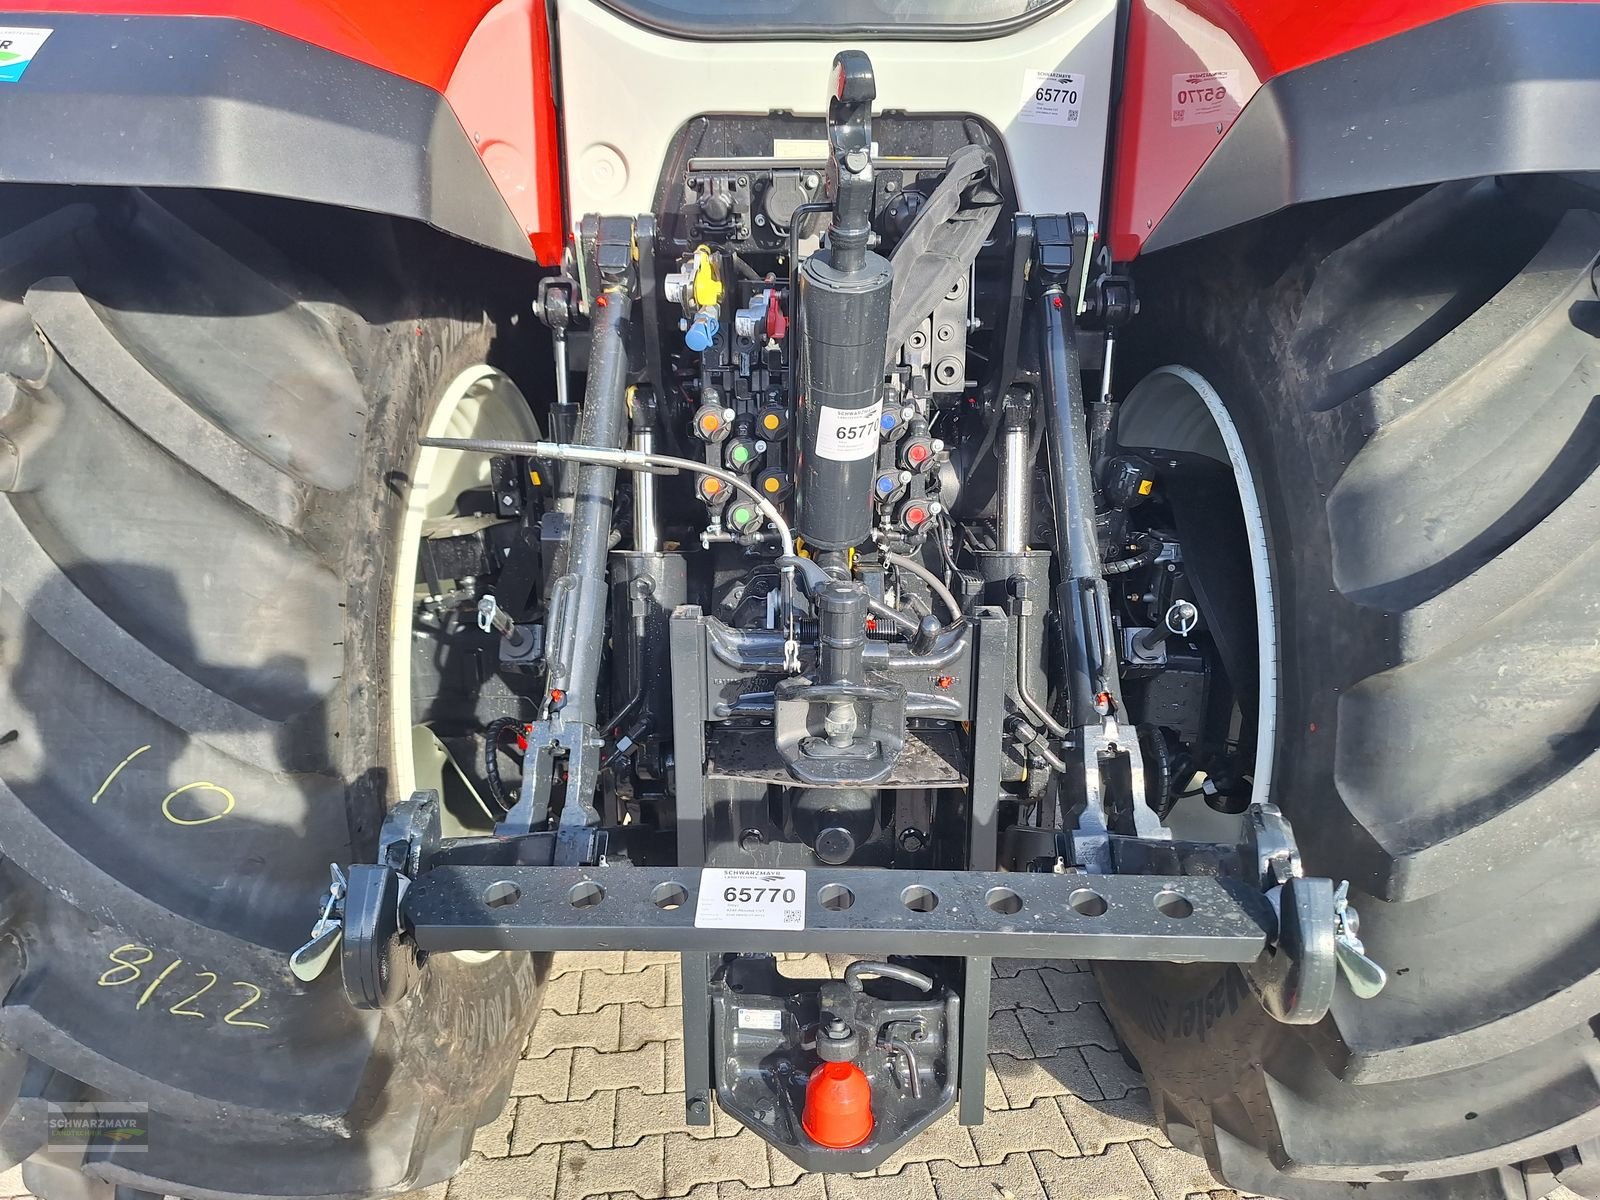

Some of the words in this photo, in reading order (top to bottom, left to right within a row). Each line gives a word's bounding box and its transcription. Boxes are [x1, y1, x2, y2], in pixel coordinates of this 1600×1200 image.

[1035, 87, 1077, 104] 65770
[836, 418, 879, 440] 65770
[723, 886, 796, 904] 65770
